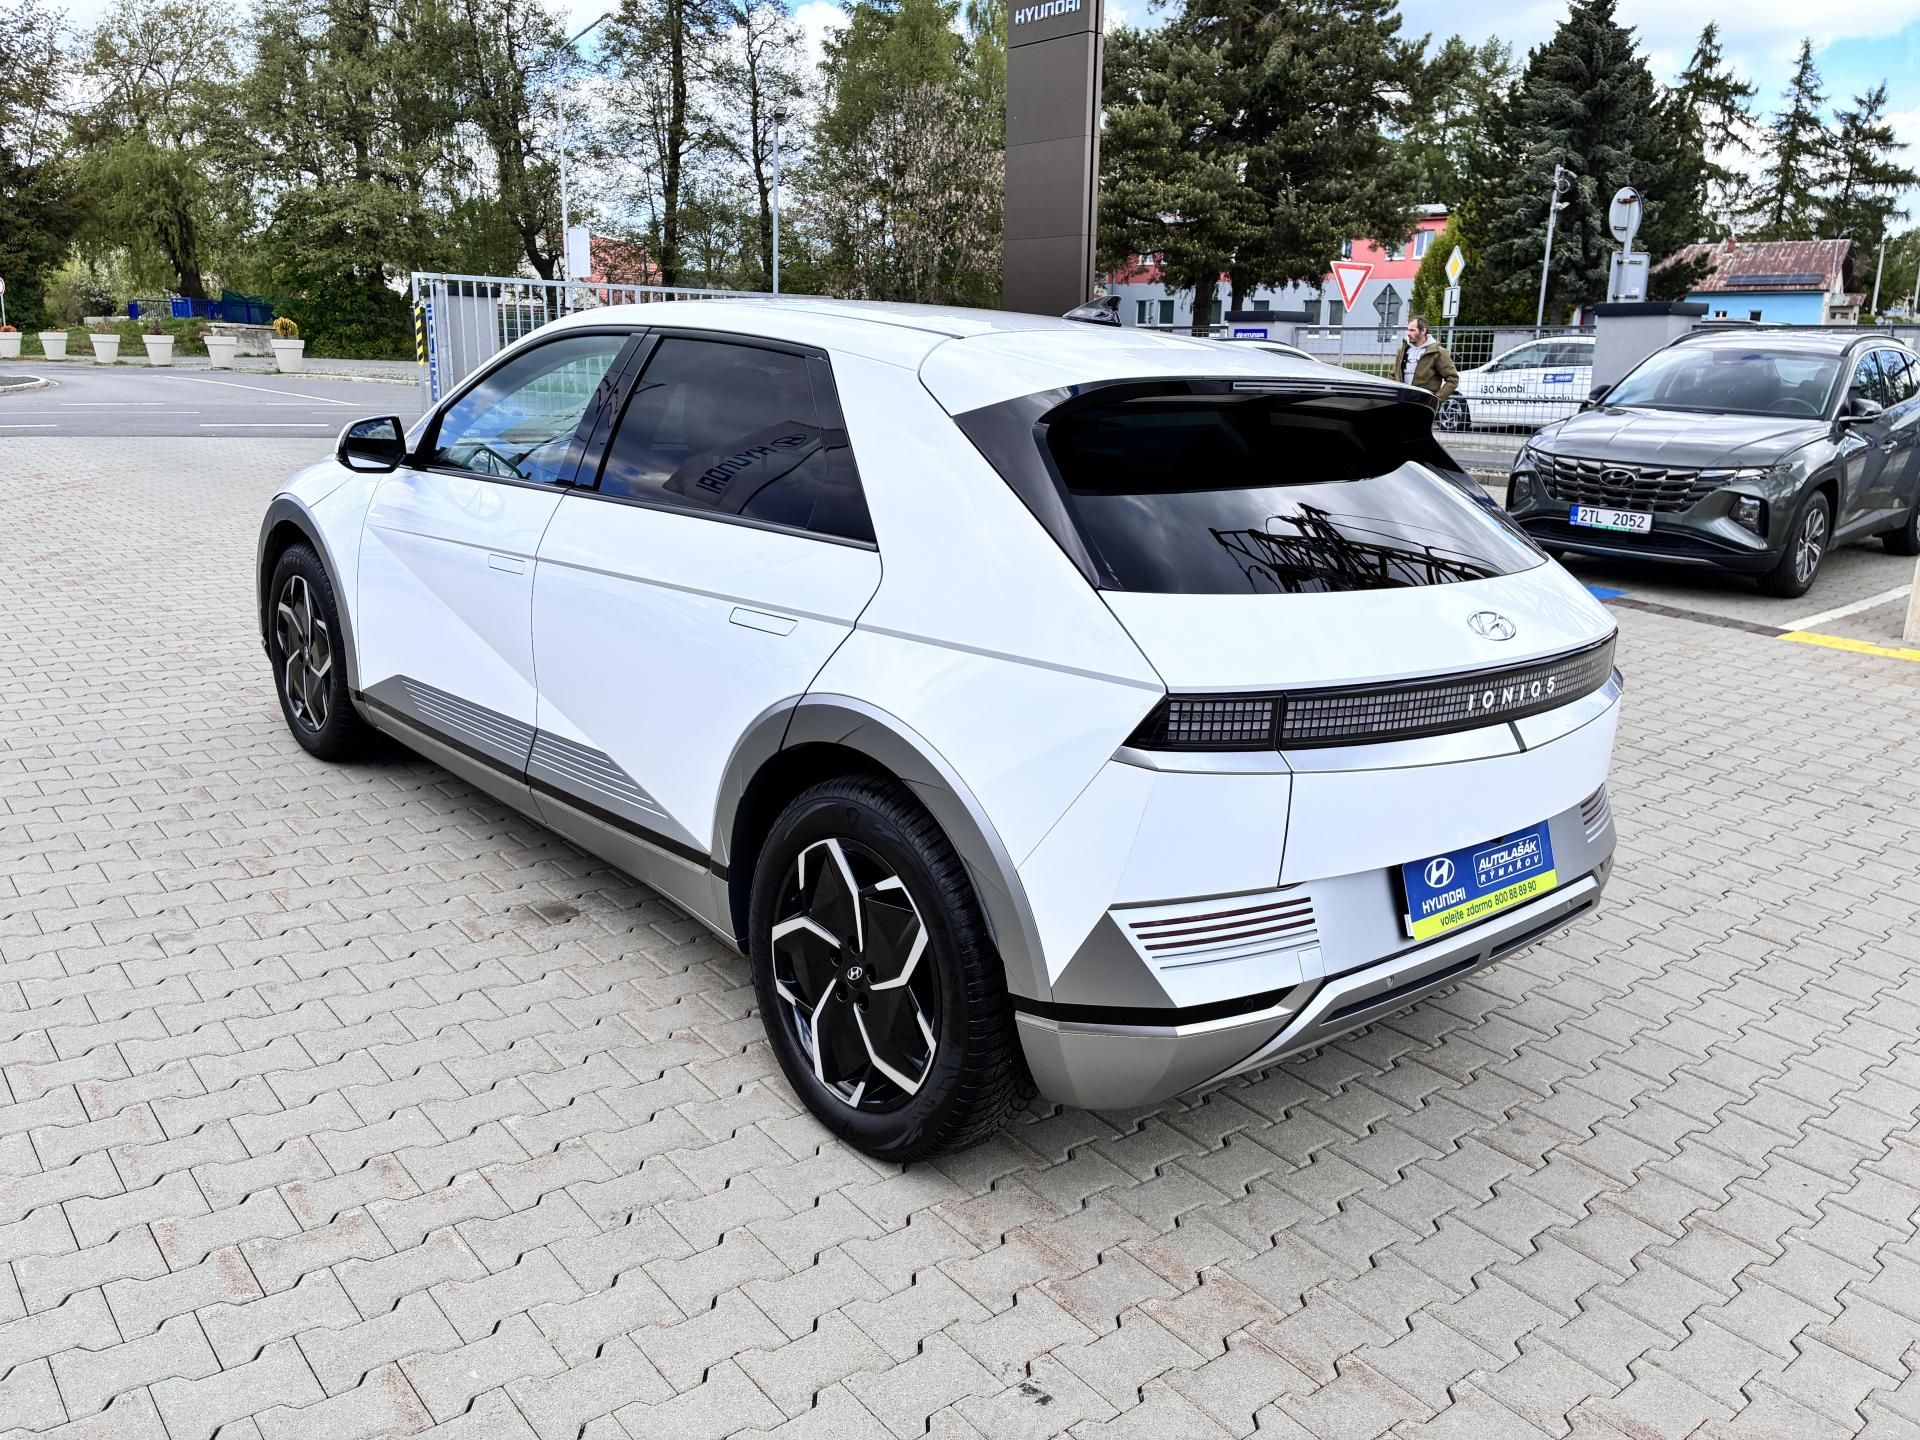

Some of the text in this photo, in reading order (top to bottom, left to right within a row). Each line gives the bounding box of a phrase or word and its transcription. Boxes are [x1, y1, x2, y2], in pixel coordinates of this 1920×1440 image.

[1015, 0, 1081, 25] HYUNDAI
[1481, 383, 1526, 394] i30 Kombi
[1580, 509, 1602, 524] 2TL
[1612, 512, 1645, 529] 2052
[1467, 676, 1555, 711] IONIQ 5
[1478, 838, 1537, 871] AUTOLAŠÁK
[1480, 854, 1539, 884] RÝMAŘOV
[1421, 887, 1466, 915] HYUNDAI
[1440, 880, 1537, 927] volejte zdarma 800 88 89 90
